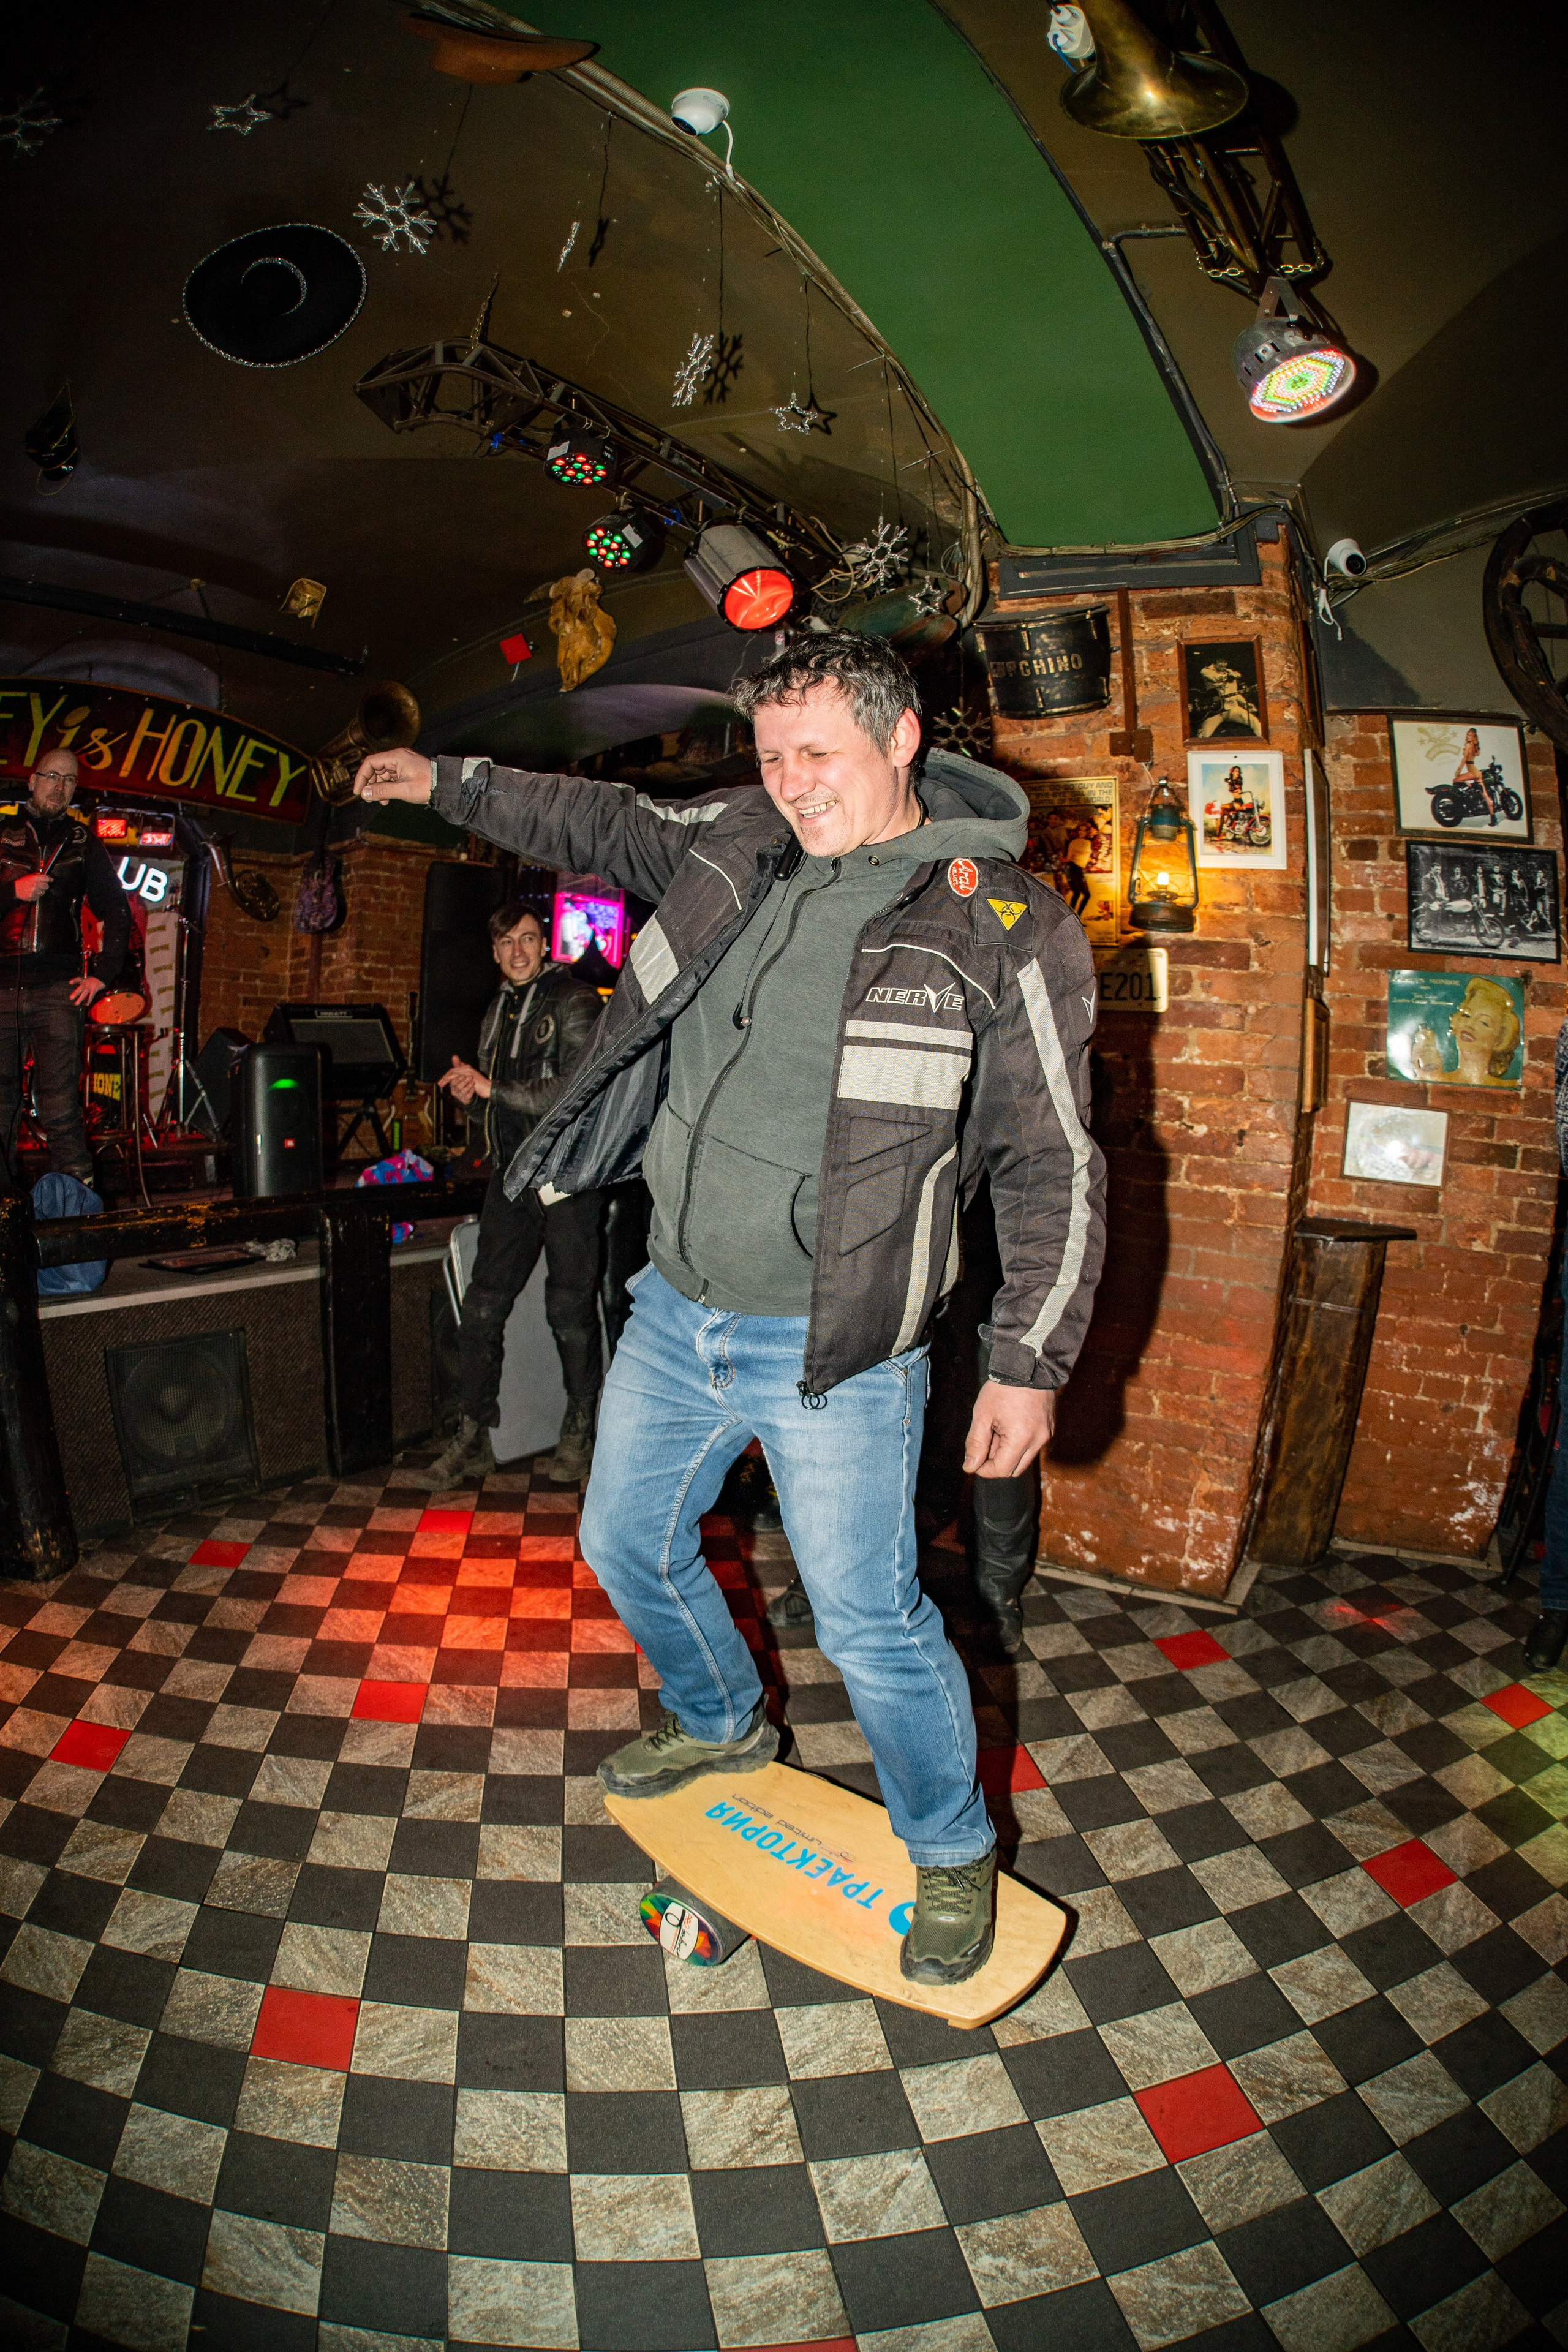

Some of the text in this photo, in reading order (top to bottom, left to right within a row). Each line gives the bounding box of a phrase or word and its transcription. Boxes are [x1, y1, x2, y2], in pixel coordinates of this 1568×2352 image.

[119, 708, 306, 807] HONEY
[118, 856, 168, 902] UB
[957, 860, 974, 891] Arai
[865, 982, 965, 1014] NERVE
[1100, 971, 1157, 1001] E201
[731, 1793, 822, 1846] Limited edition
[704, 1801, 884, 1909] ТРАЕКТОРИЯ
